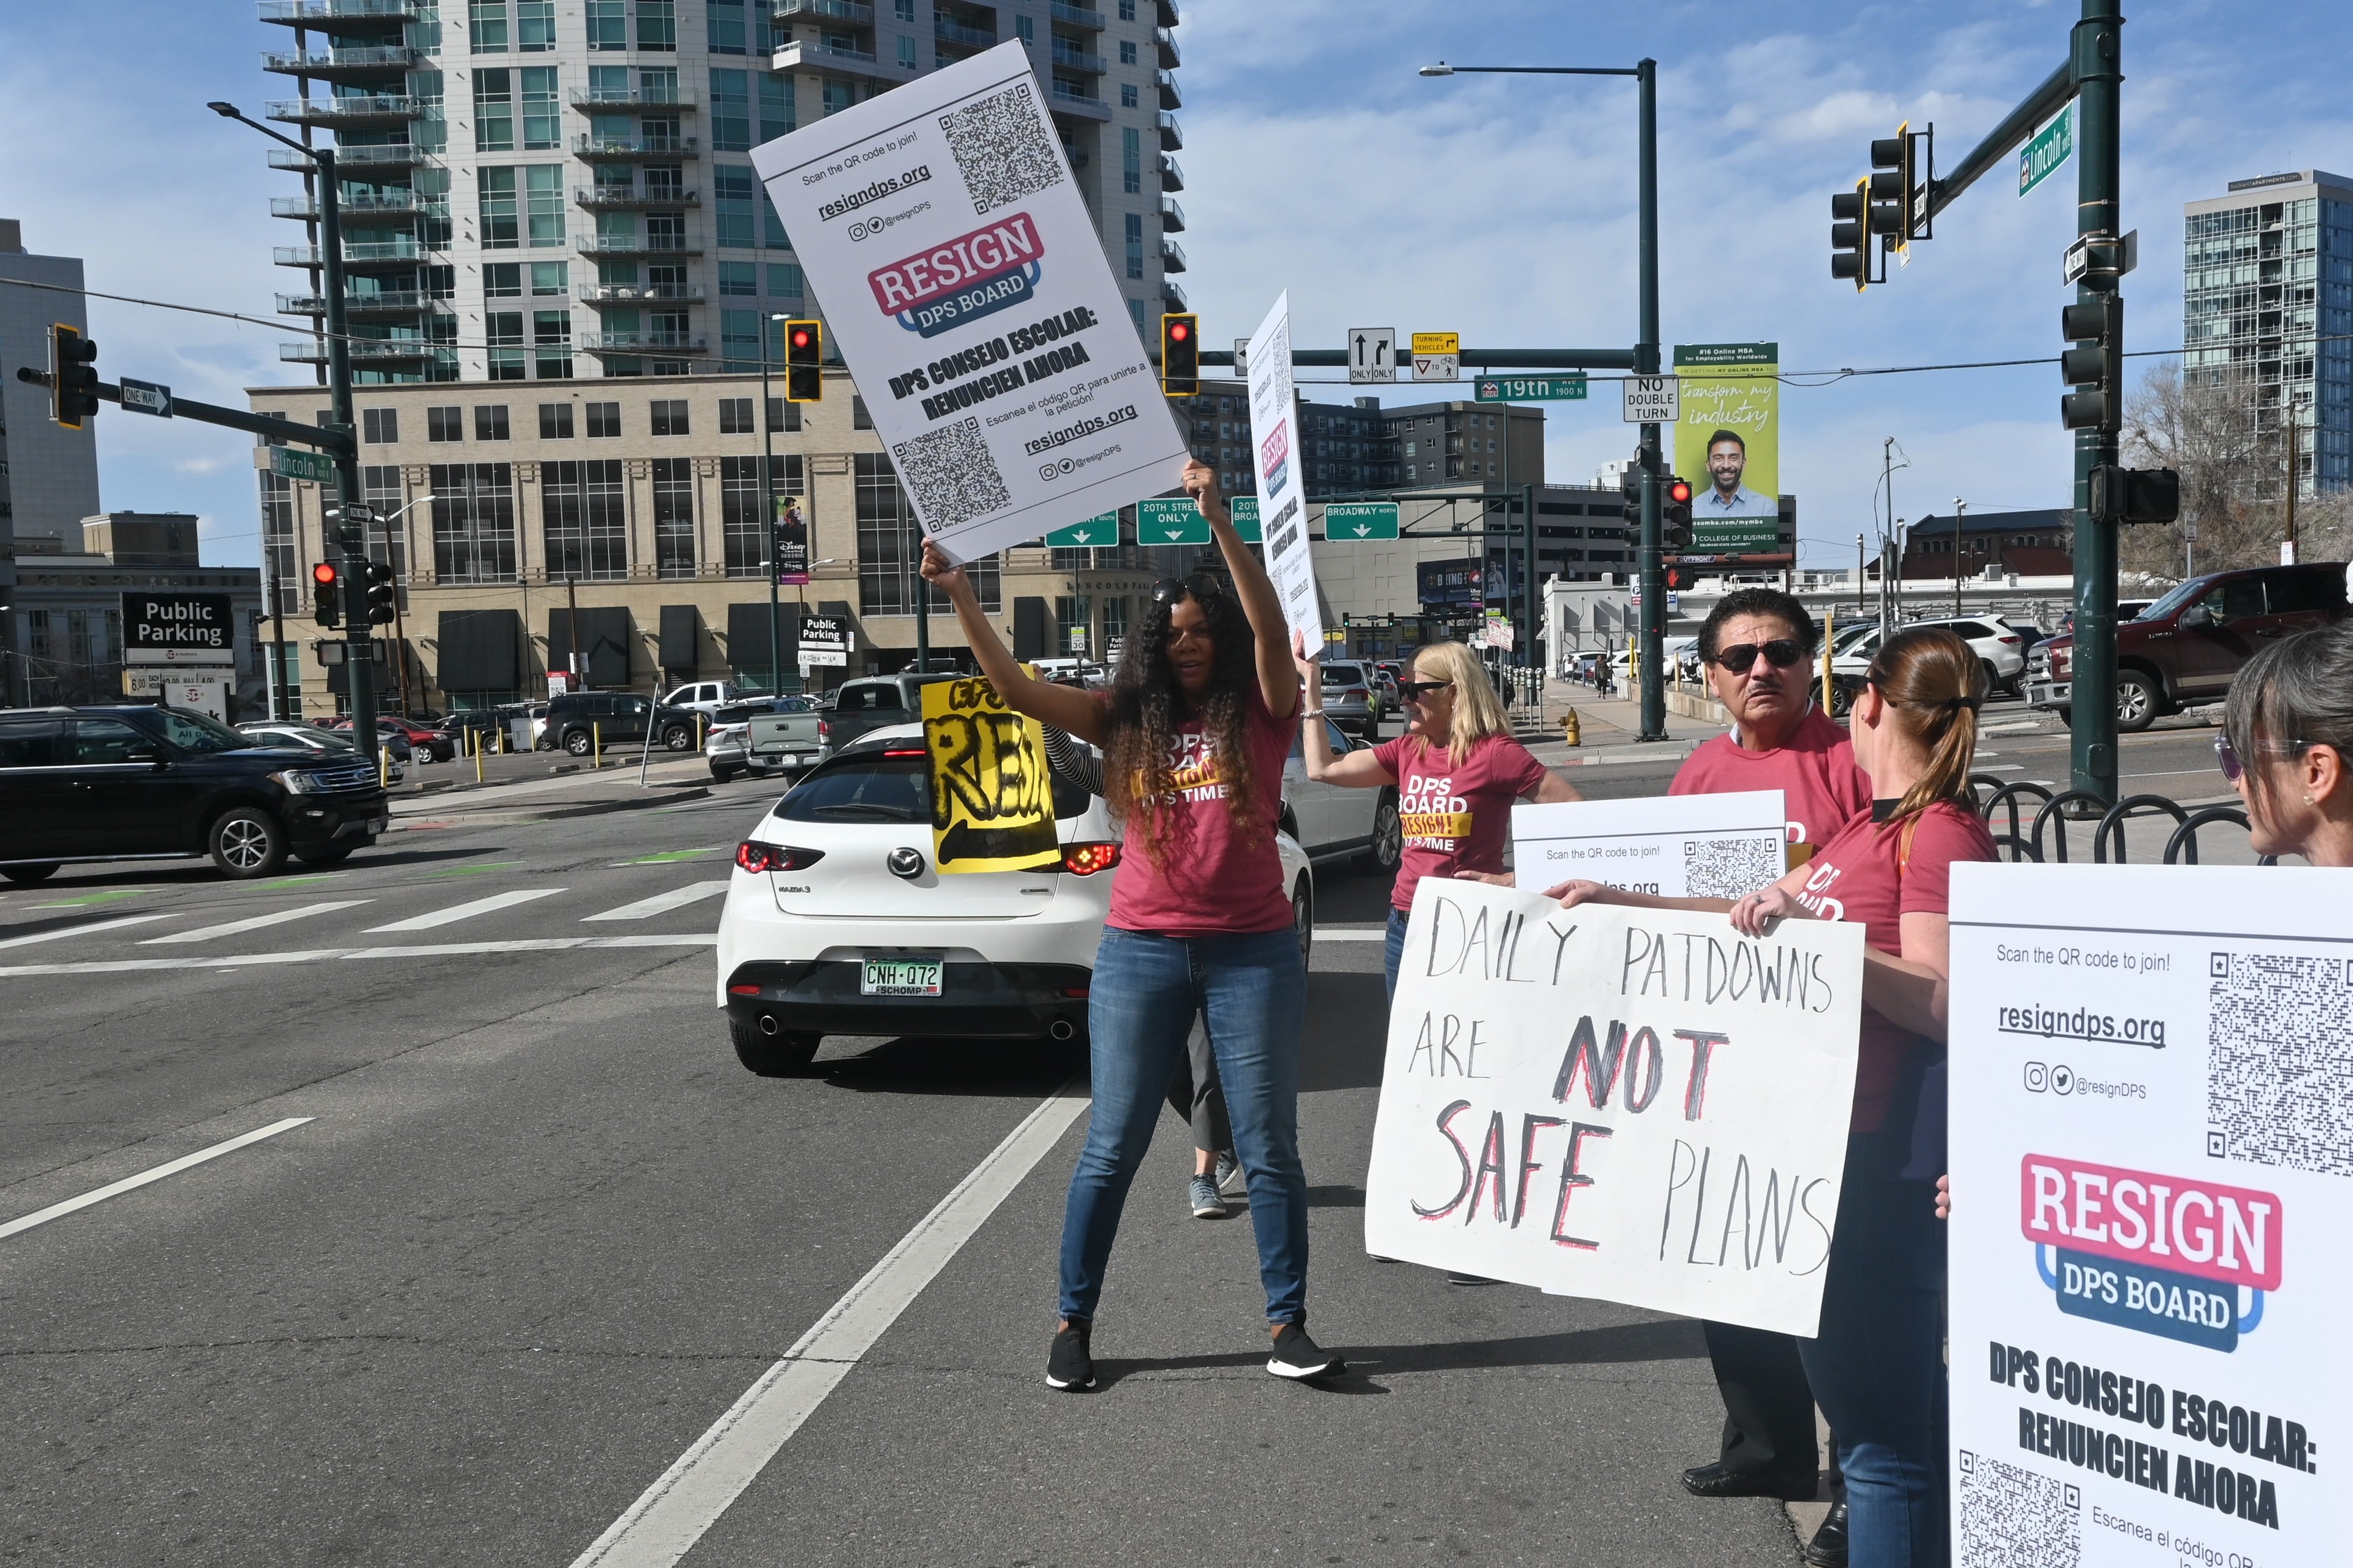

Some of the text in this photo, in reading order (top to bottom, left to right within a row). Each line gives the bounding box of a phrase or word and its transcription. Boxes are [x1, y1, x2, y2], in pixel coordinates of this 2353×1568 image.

[802, 132, 918, 186] Scan the QR code to join!
[2030, 128, 2060, 181] Lincoln
[818, 164, 932, 219] resigndps.org
[2230, 174, 2298, 189] RADIANTAPARTMENTS.COM
[885, 201, 931, 227] @resignDPS
[876, 219, 1033, 308] RESIGN
[918, 275, 1024, 328] DPS BOARD
[888, 306, 1098, 400] DPS CONSEJO ESCOLAR:
[921, 342, 1090, 421] RENUNCIEN AHORA
[1352, 370, 1371, 378] ONLY
[1374, 369, 1393, 378] ONLY
[1639, 379, 1663, 392] NO
[126, 388, 156, 405] ONE WAY
[986, 406, 1026, 427] Escanea
[1027, 401, 1036, 412] el
[1038, 390, 1068, 409] código
[1070, 383, 1086, 396] QR
[1088, 375, 1109, 392] para
[1111, 366, 1137, 381] unirte
[1504, 380, 1549, 397] 19th
[1629, 394, 1674, 405] DOUBLE
[1682, 380, 1772, 404] transform my
[1045, 392, 1095, 417] la petición!
[1636, 408, 1668, 419] TURN
[1689, 399, 1768, 432] industry
[1024, 404, 1138, 456] resigndps.org
[1075, 445, 1121, 468] @resignDPS
[1262, 422, 1286, 473] RESIGN
[279, 452, 314, 476] Lincoln
[1143, 503, 1198, 512] 20TH STREE
[1158, 514, 1189, 522] ONLY
[1235, 512, 1260, 521] BROA
[1327, 507, 1377, 515] BROADWAY
[146, 602, 212, 620] Public
[138, 624, 222, 646] Parking
[803, 629, 840, 642] Parking
[807, 619, 836, 629] Public
[132, 678, 146, 691] 6.00
[1181, 784, 1229, 803] TIME
[1407, 775, 1452, 796] DPS
[1399, 794, 1467, 814] BOARD
[1402, 815, 1452, 835] RESIGN!
[1404, 836, 1454, 852] IT'S TIME
[1547, 845, 1660, 860] Scan the QR code to join!
[1427, 896, 1832, 1013] DAILY PATDOWNS
[1997, 944, 2170, 974] Scan the QR code to join!
[1998, 1003, 2166, 1049] resigndps.org
[1408, 1010, 1730, 1121] ARE NOT
[2076, 1076, 2146, 1100] @resignDPS
[1411, 1100, 1831, 1276] SAFE PLANS
[2031, 1165, 2270, 1275] RESIGN
[2064, 1263, 2230, 1329] DPS BOARD
[1990, 1341, 2317, 1475] DPS CONSEJO ESCOLAR:
[2019, 1407, 2280, 1530] RENUNCIEN AHORA
[2093, 1506, 2152, 1542] Escanea
[2158, 1530, 2170, 1548] el
[2175, 1537, 2223, 1567] código
